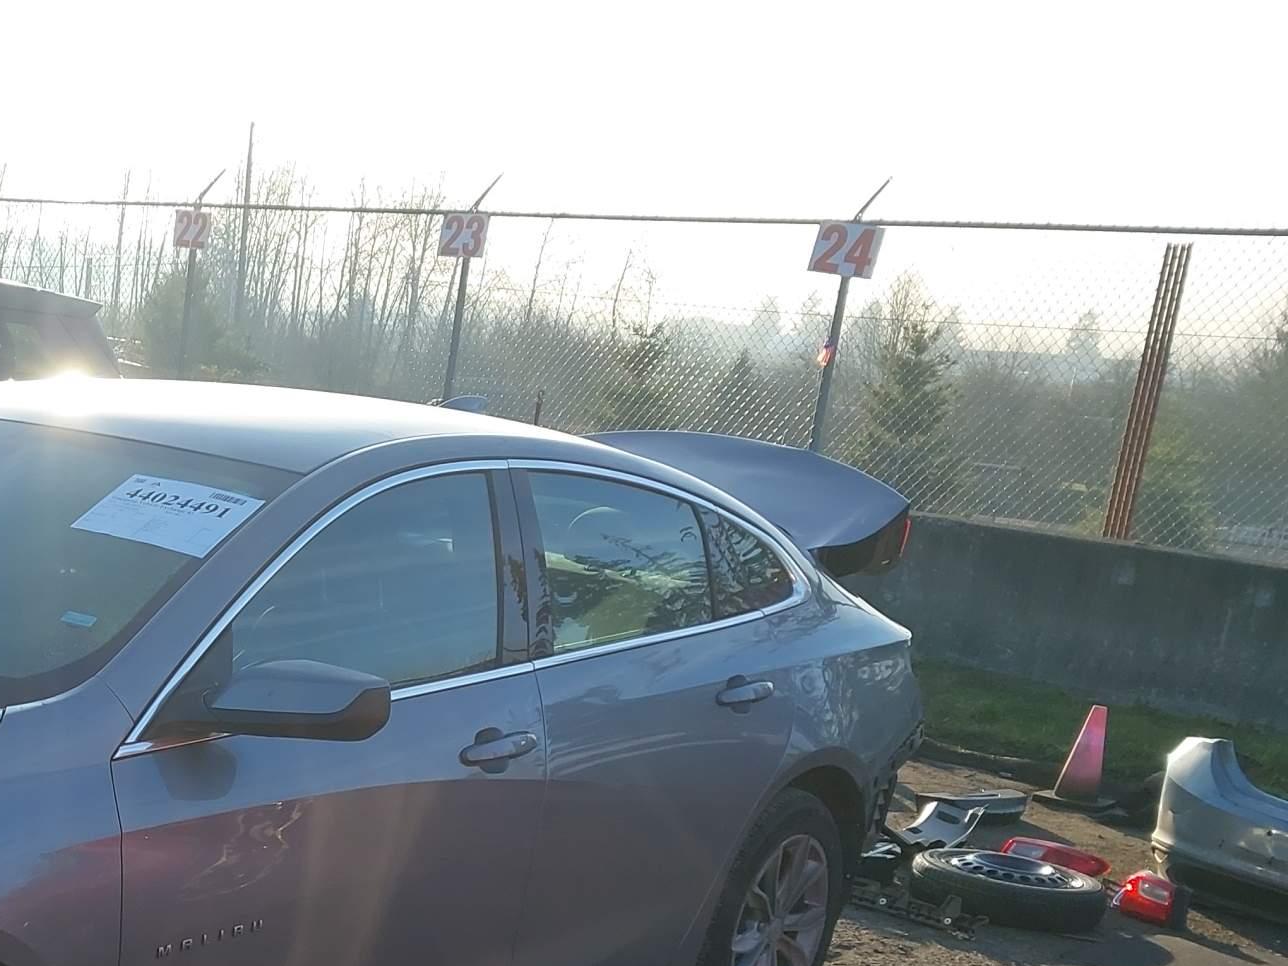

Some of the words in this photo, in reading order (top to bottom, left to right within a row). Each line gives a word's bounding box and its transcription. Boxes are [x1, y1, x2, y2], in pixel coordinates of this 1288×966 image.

[176, 211, 208, 248] 22
[440, 214, 485, 257] 23
[813, 223, 876, 274] 24
[125, 488, 232, 518] 44024491
